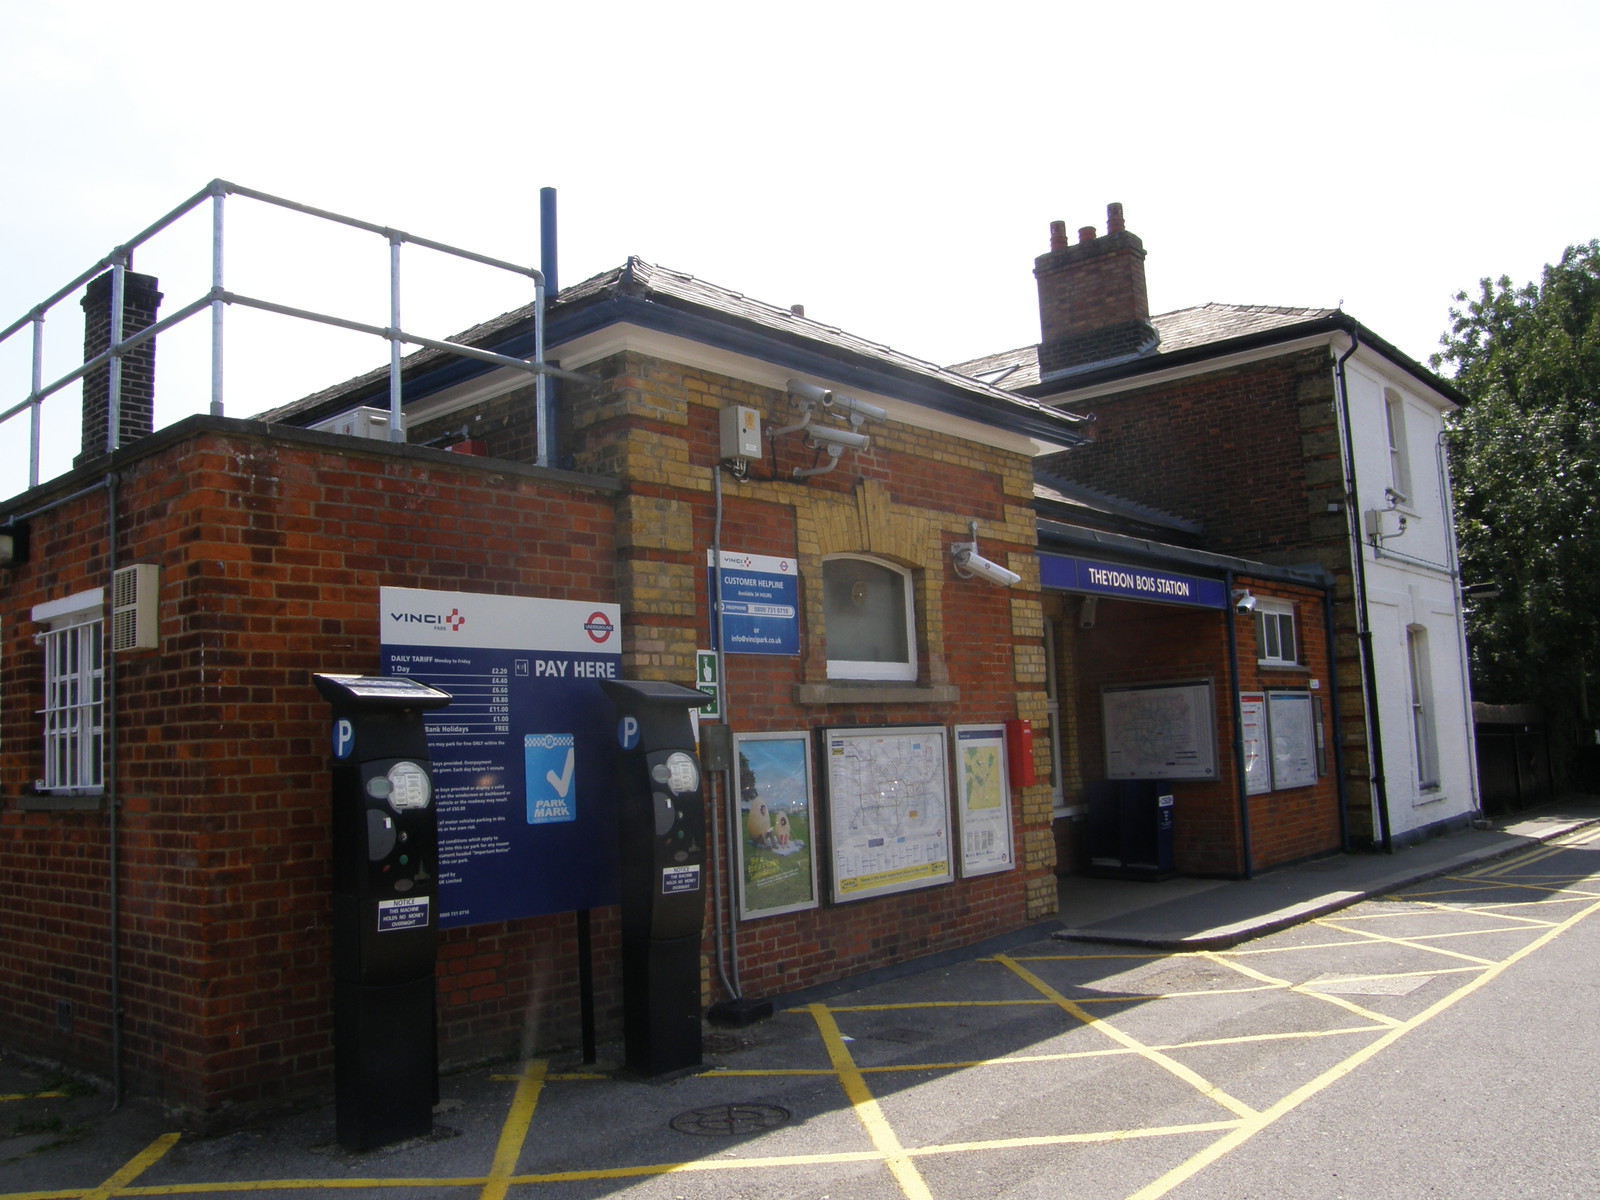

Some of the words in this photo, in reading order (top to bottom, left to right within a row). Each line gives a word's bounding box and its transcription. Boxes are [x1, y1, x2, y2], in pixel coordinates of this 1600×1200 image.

[724, 576, 756, 586] CUSTOMER
[758, 580, 784, 588] HELPLINE
[1088, 568, 1134, 589] THEYDON
[1136, 576, 1155, 592] BOIS
[1156, 579, 1189, 596] STATION
[390, 612, 441, 624] VINCI
[535, 660, 568, 677] PAY
[574, 662, 616, 678] HERE
[442, 726, 468, 734] Holidays
[624, 716, 637, 747] P
[338, 720, 351, 756] P
[536, 799, 566, 808] PARK
[534, 806, 570, 817] MARK
